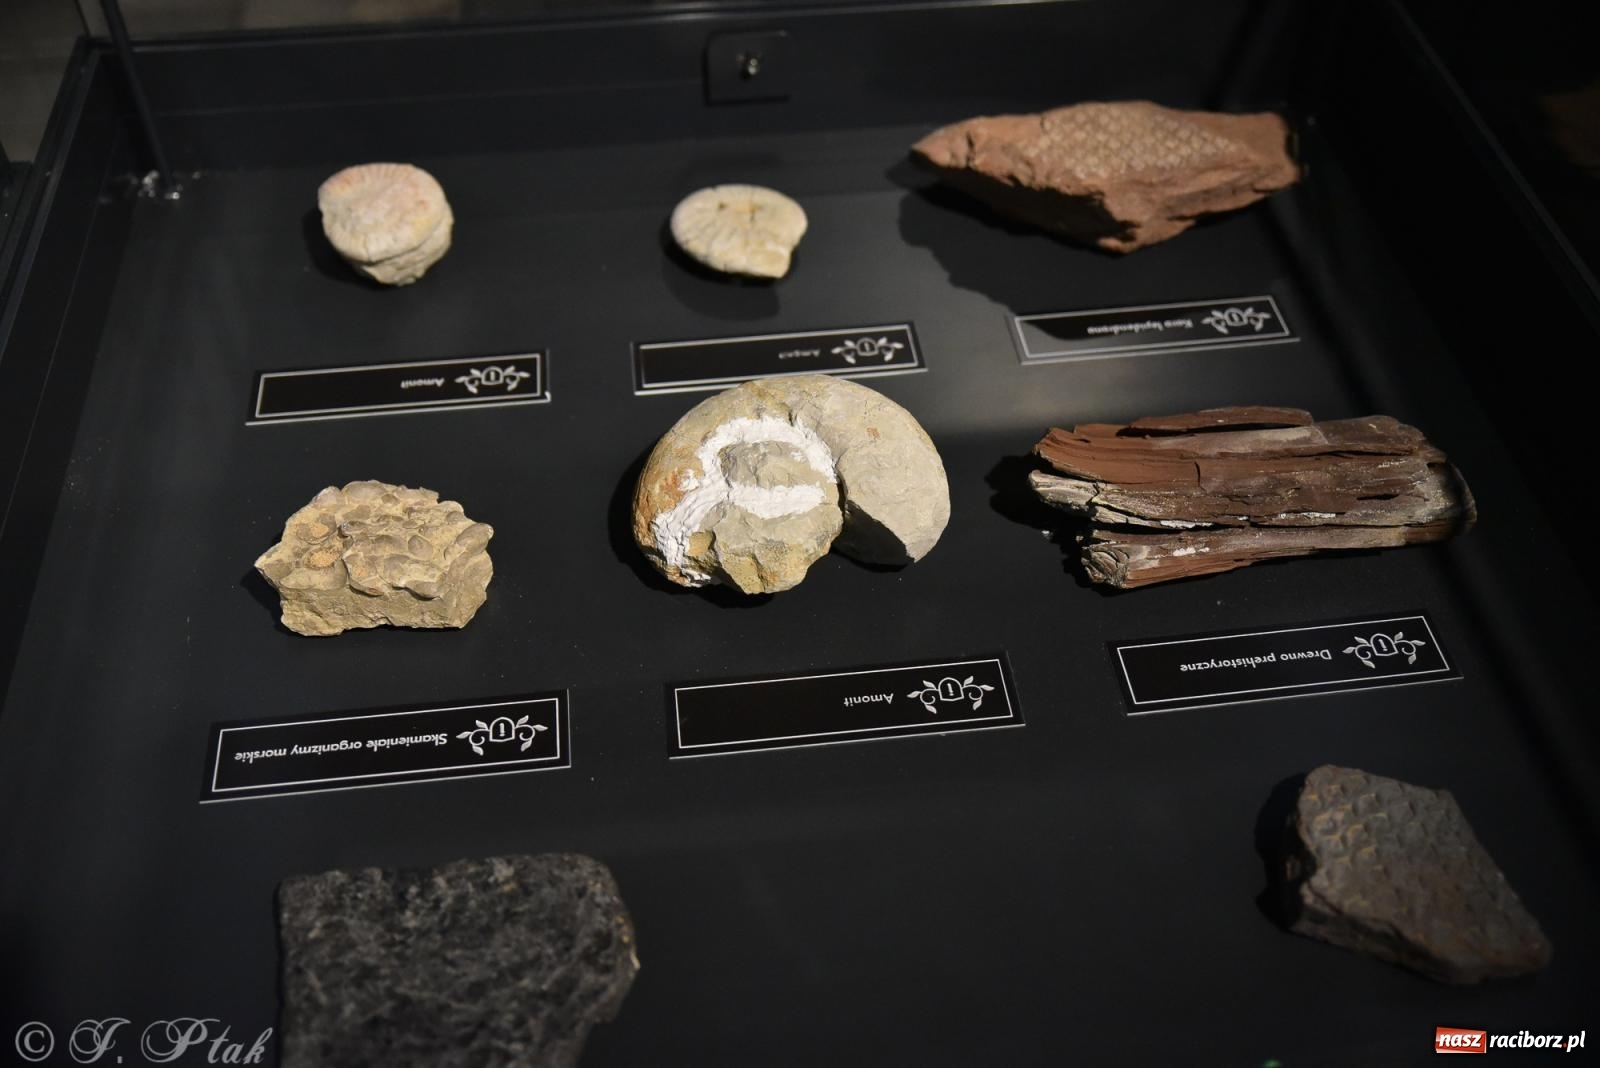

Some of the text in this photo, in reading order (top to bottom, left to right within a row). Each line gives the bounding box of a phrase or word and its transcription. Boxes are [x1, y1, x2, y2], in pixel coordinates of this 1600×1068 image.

[401, 377, 446, 389] Amonit
[1180, 649, 1332, 672] Drewno prehistoryczne
[844, 692, 894, 707] Amonit
[290, 740, 362, 755] organizmy
[234, 748, 288, 763] morskie
